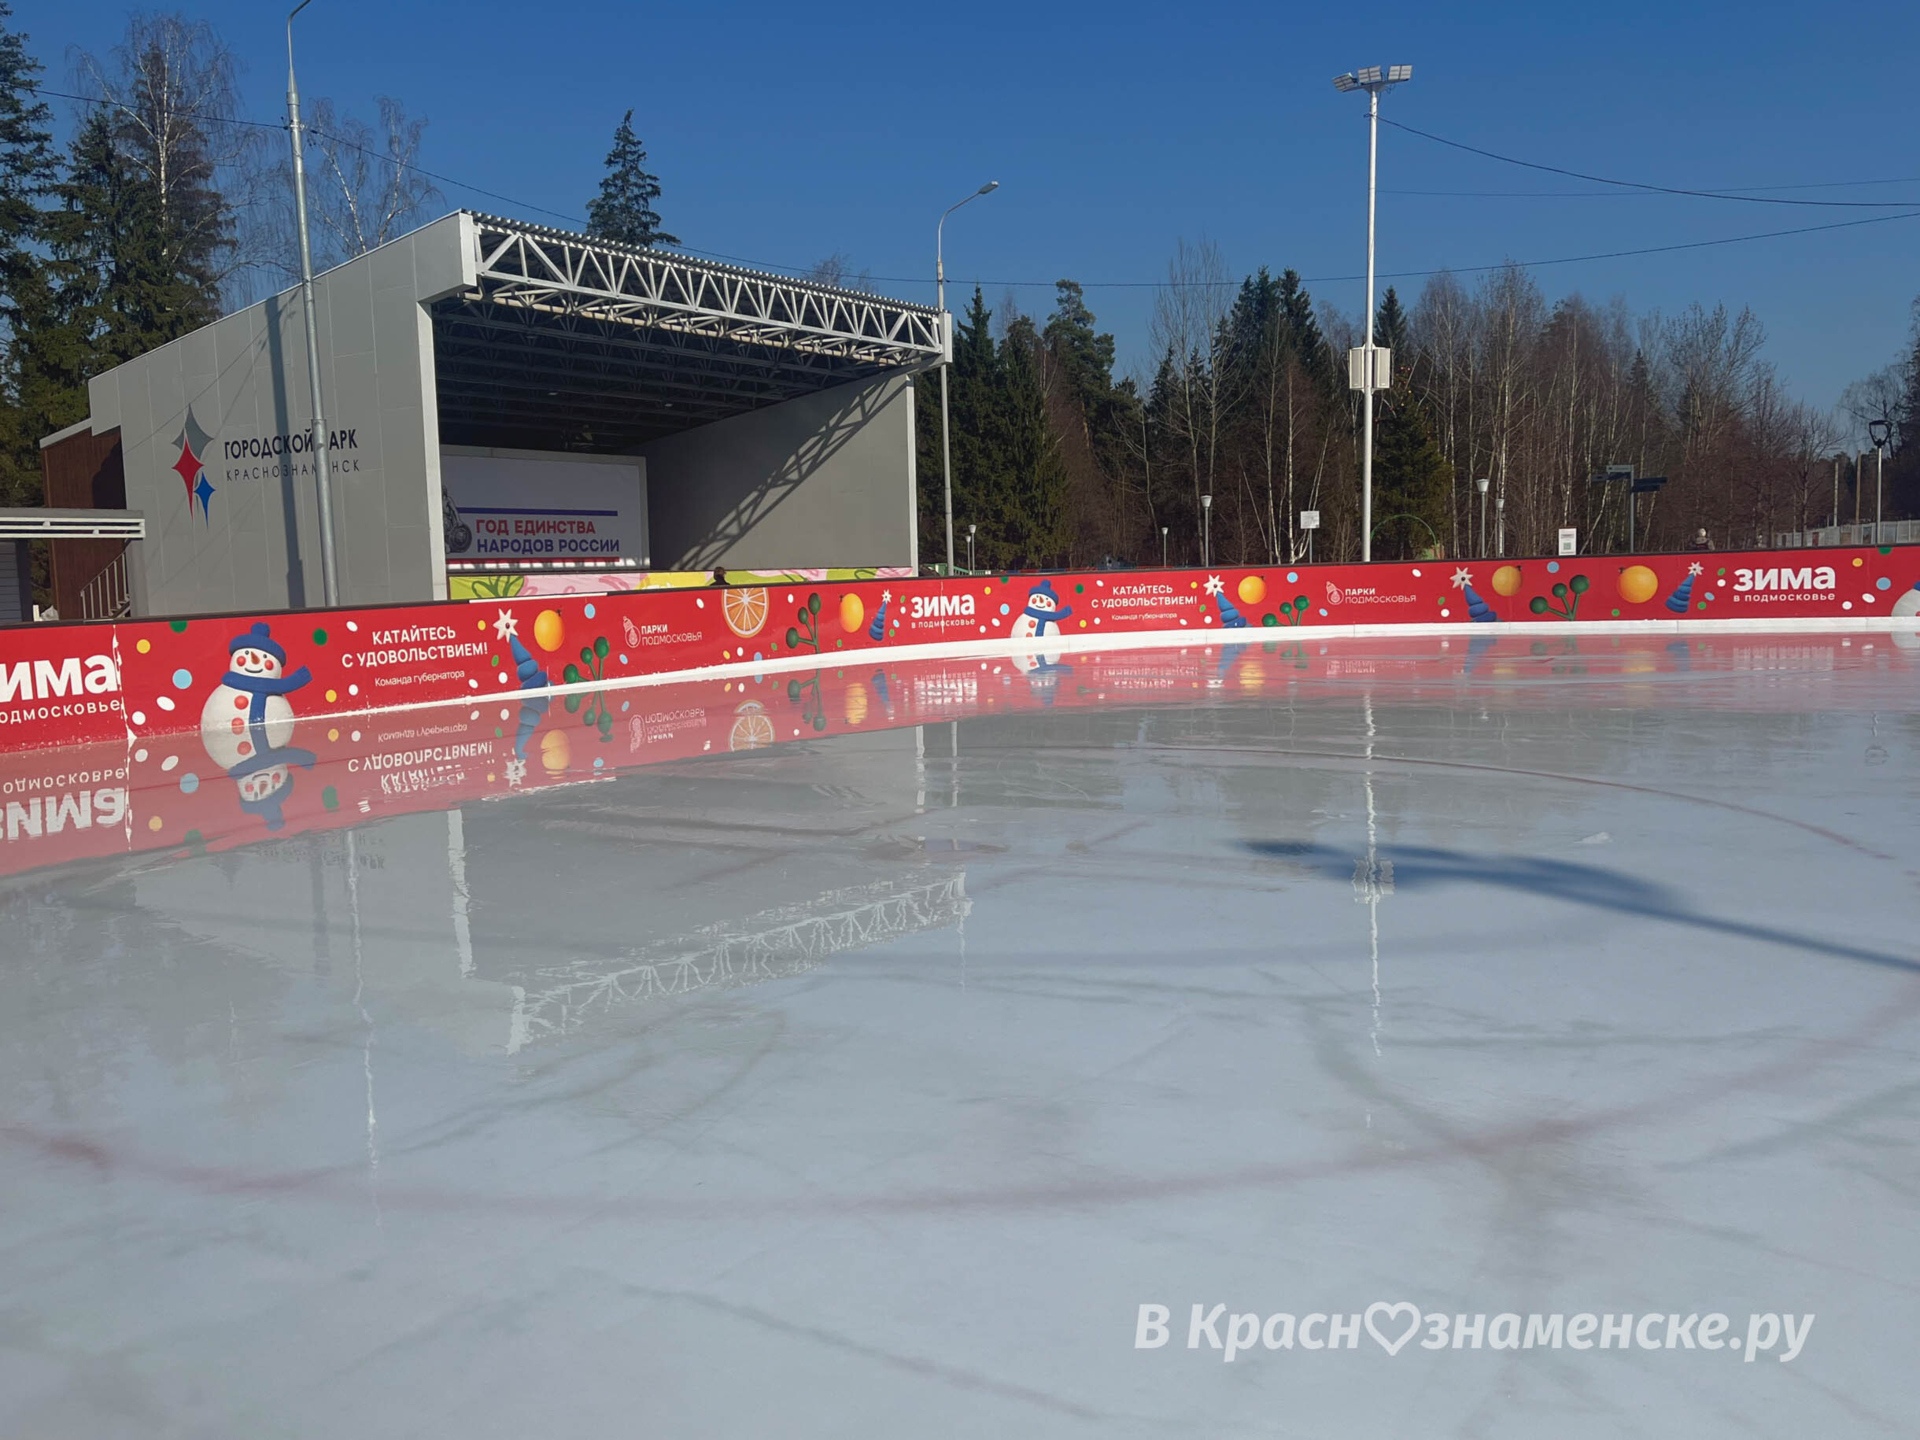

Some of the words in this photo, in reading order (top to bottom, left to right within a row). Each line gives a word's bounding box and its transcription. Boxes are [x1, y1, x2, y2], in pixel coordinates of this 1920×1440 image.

[224, 428, 313, 460] ГОРОДСКОЙ
[329, 428, 358, 451] АРК
[226, 459, 360, 482] КРАСНОЗНАНСК
[476, 519, 509, 536] ГОД
[514, 520, 596, 536] ЕДИНСТВА
[477, 538, 554, 554] НАРОДОВ
[559, 539, 620, 553] РОССИИ
[1112, 583, 1173, 596] КАТАЙТЕСЬ
[1345, 588, 1376, 596] ПАРКИ
[1091, 599, 1099, 608] С
[1101, 596, 1198, 608] УДОВОЛЬСТВИЕМ!
[1345, 594, 1417, 604] ПОДМОСКОВЬЯ
[1745, 593, 1836, 603] подмосковье
[1139, 612, 1178, 621] губернатора
[372, 625, 457, 646] КАТАЙТЕСЬ
[641, 624, 668, 635] ПАРКИ
[642, 631, 703, 646] ПОДМОСКОВЬЯ
[341, 653, 354, 668] С
[356, 642, 488, 668] УДОВОЛЬСТВИЕМ!
[374, 675, 413, 687] Команда
[413, 670, 466, 684] губернатора
